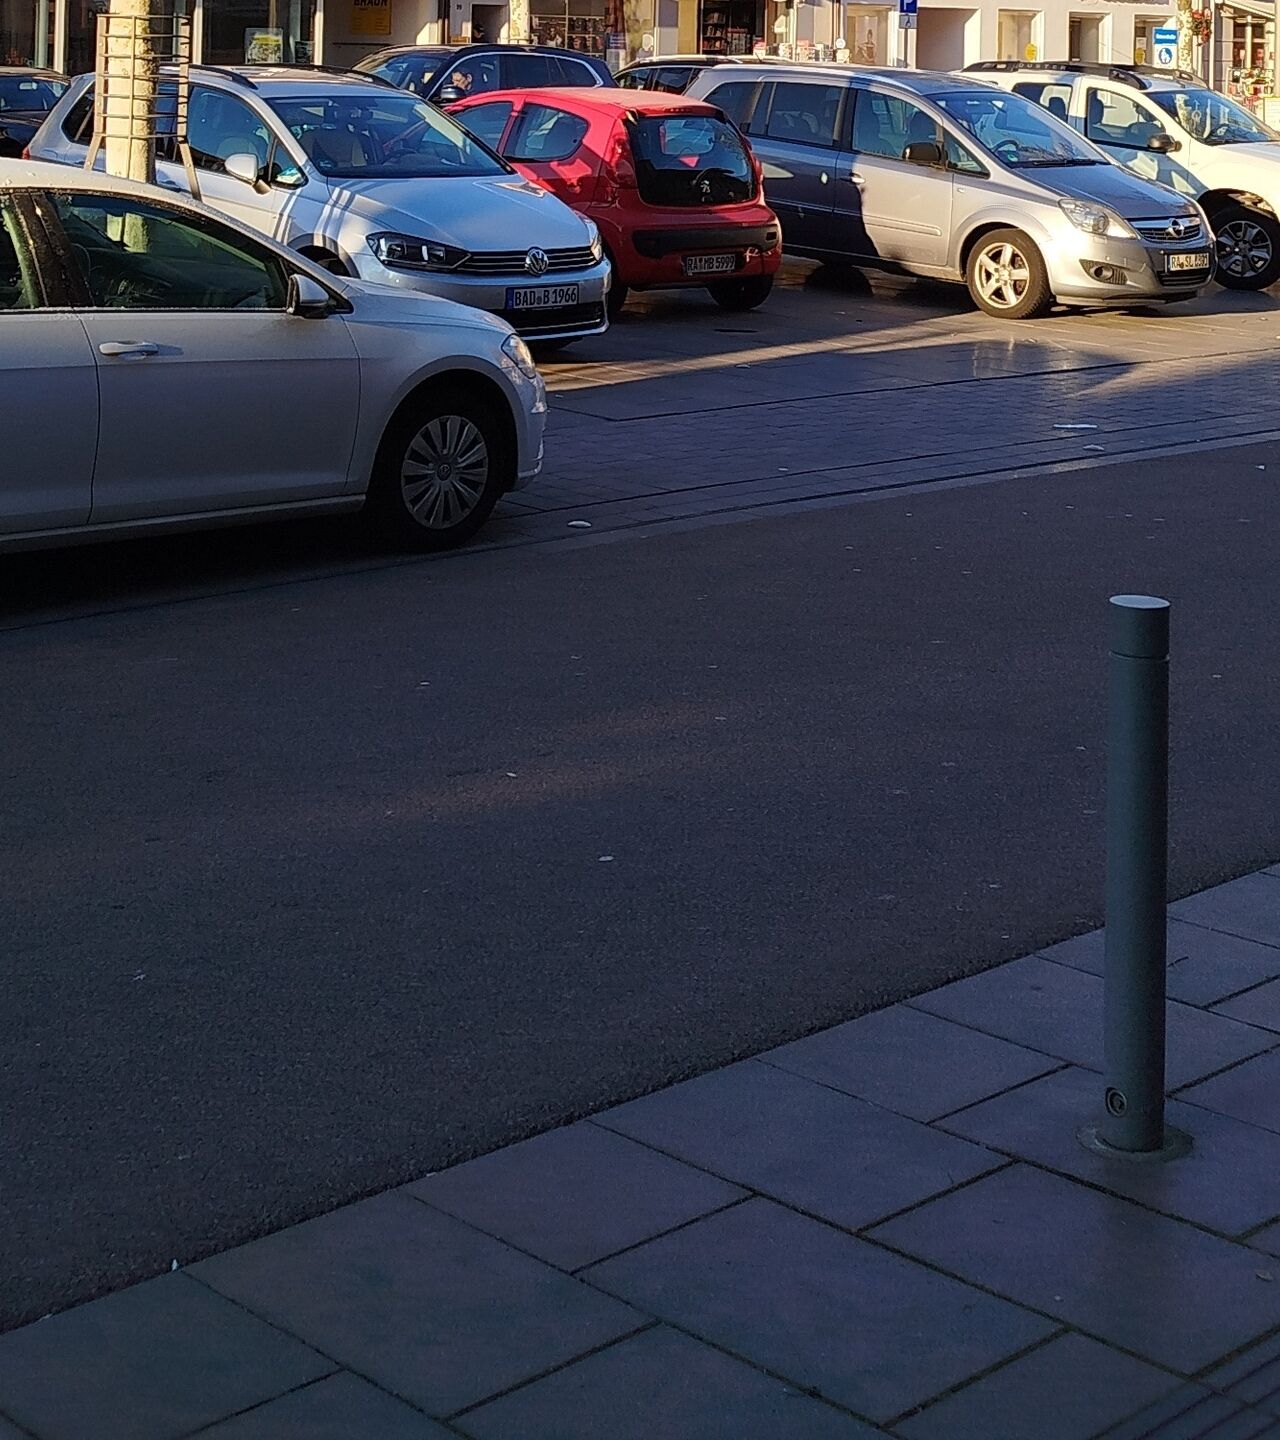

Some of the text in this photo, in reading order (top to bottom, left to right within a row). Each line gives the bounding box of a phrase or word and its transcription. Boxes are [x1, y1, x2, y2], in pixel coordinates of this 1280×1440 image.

[514, 288, 577, 306] BAD B 1966
